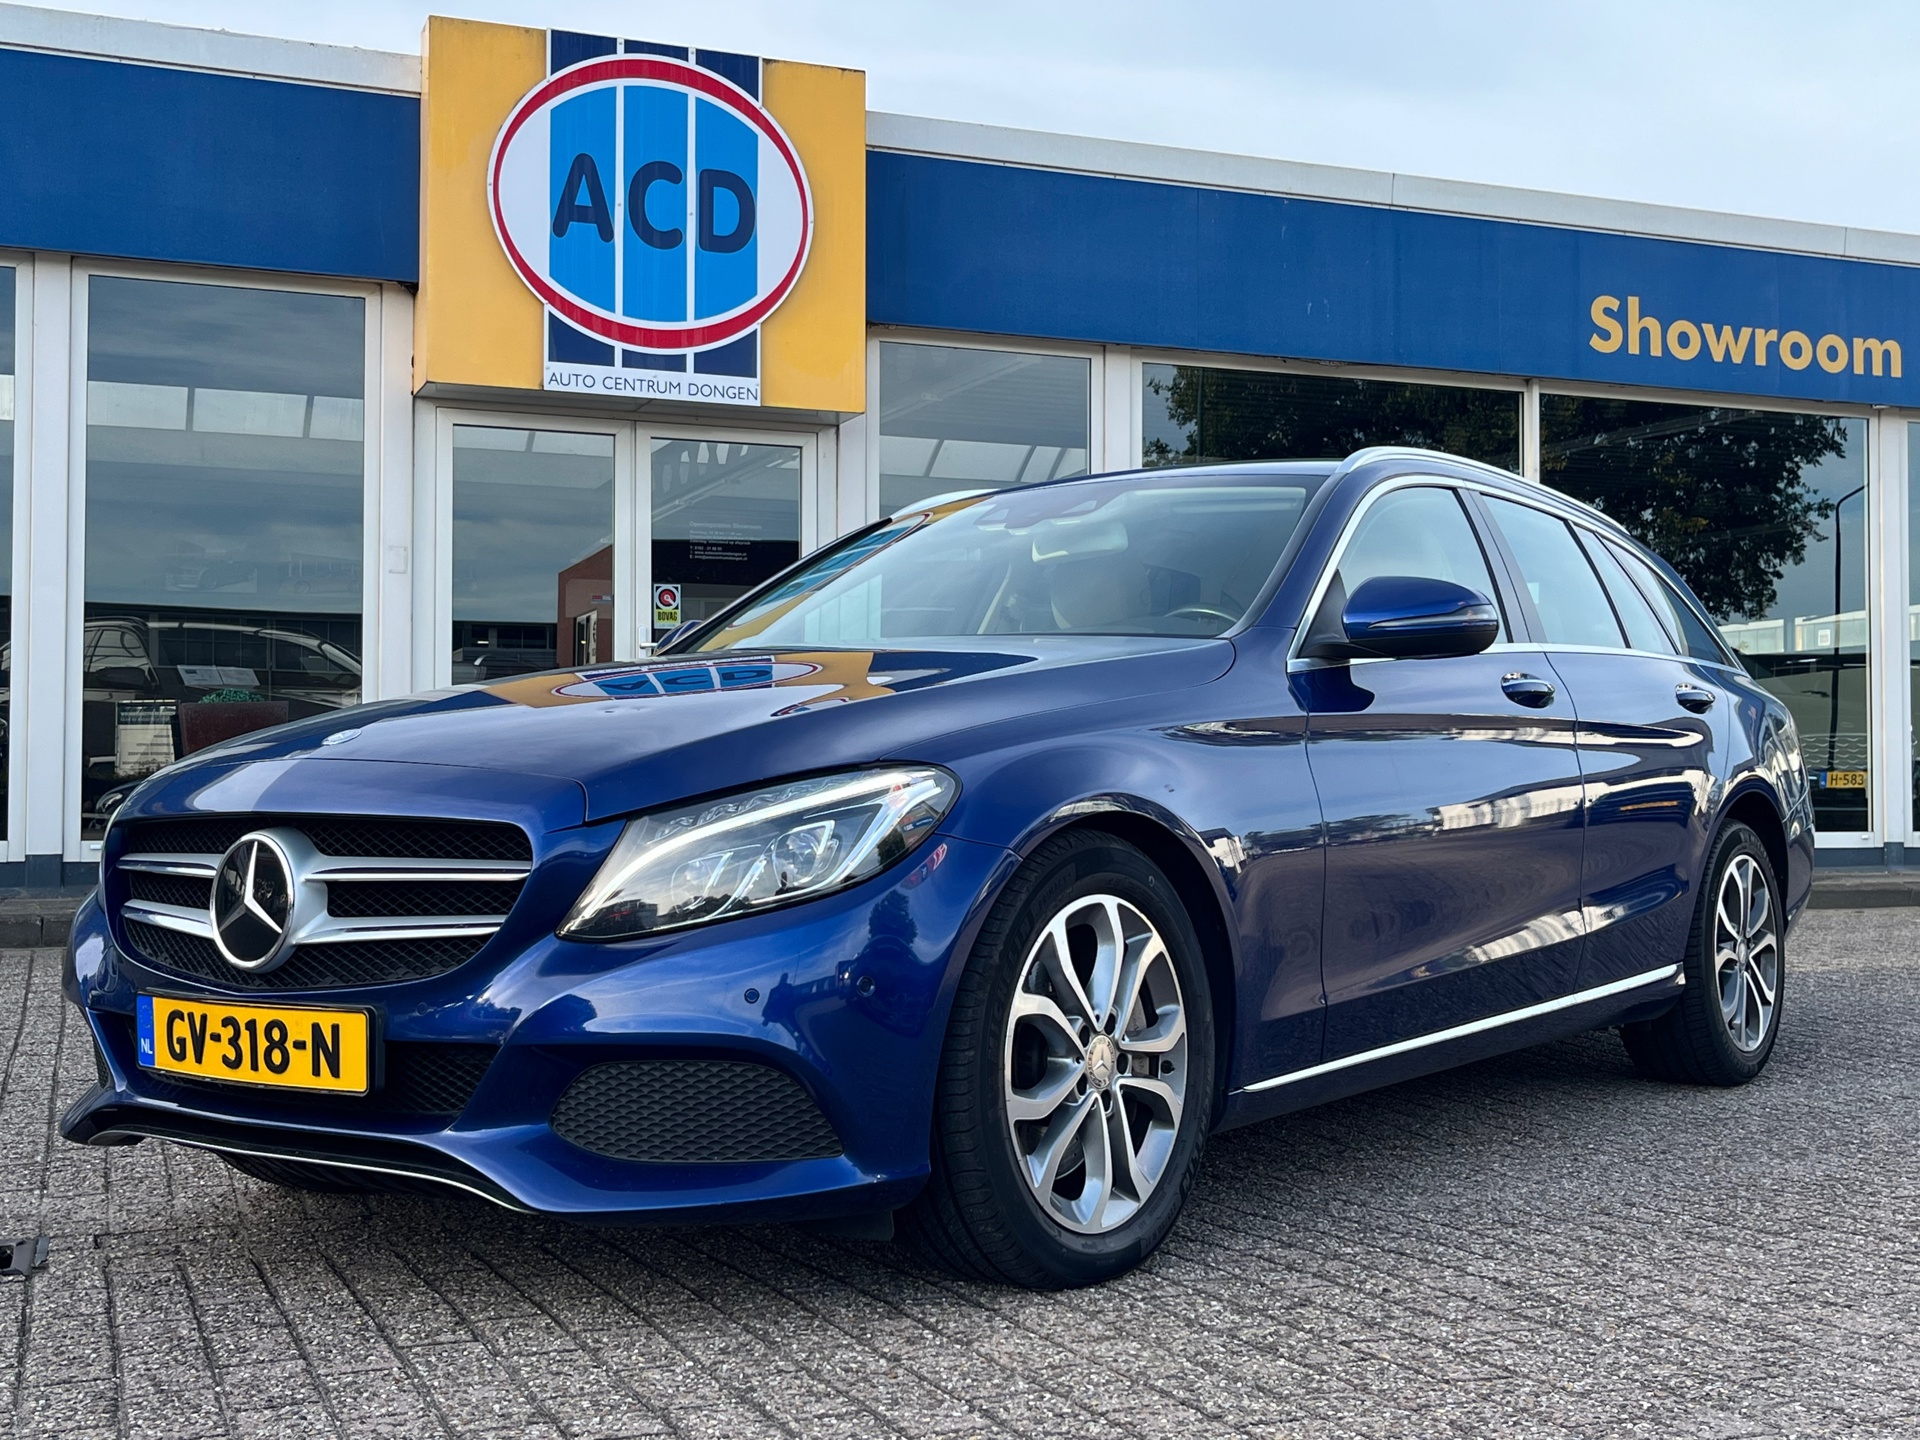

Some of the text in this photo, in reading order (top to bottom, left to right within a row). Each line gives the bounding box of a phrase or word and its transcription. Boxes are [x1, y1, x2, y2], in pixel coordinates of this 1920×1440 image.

[552, 152, 756, 254] ACD
[1589, 295, 1902, 378] Showroom
[548, 372, 758, 401] AUTO CENTRUM DONGEN
[657, 611, 678, 622] BOVAG
[141, 1038, 153, 1055] NL
[166, 1009, 340, 1078] GV-318-N
